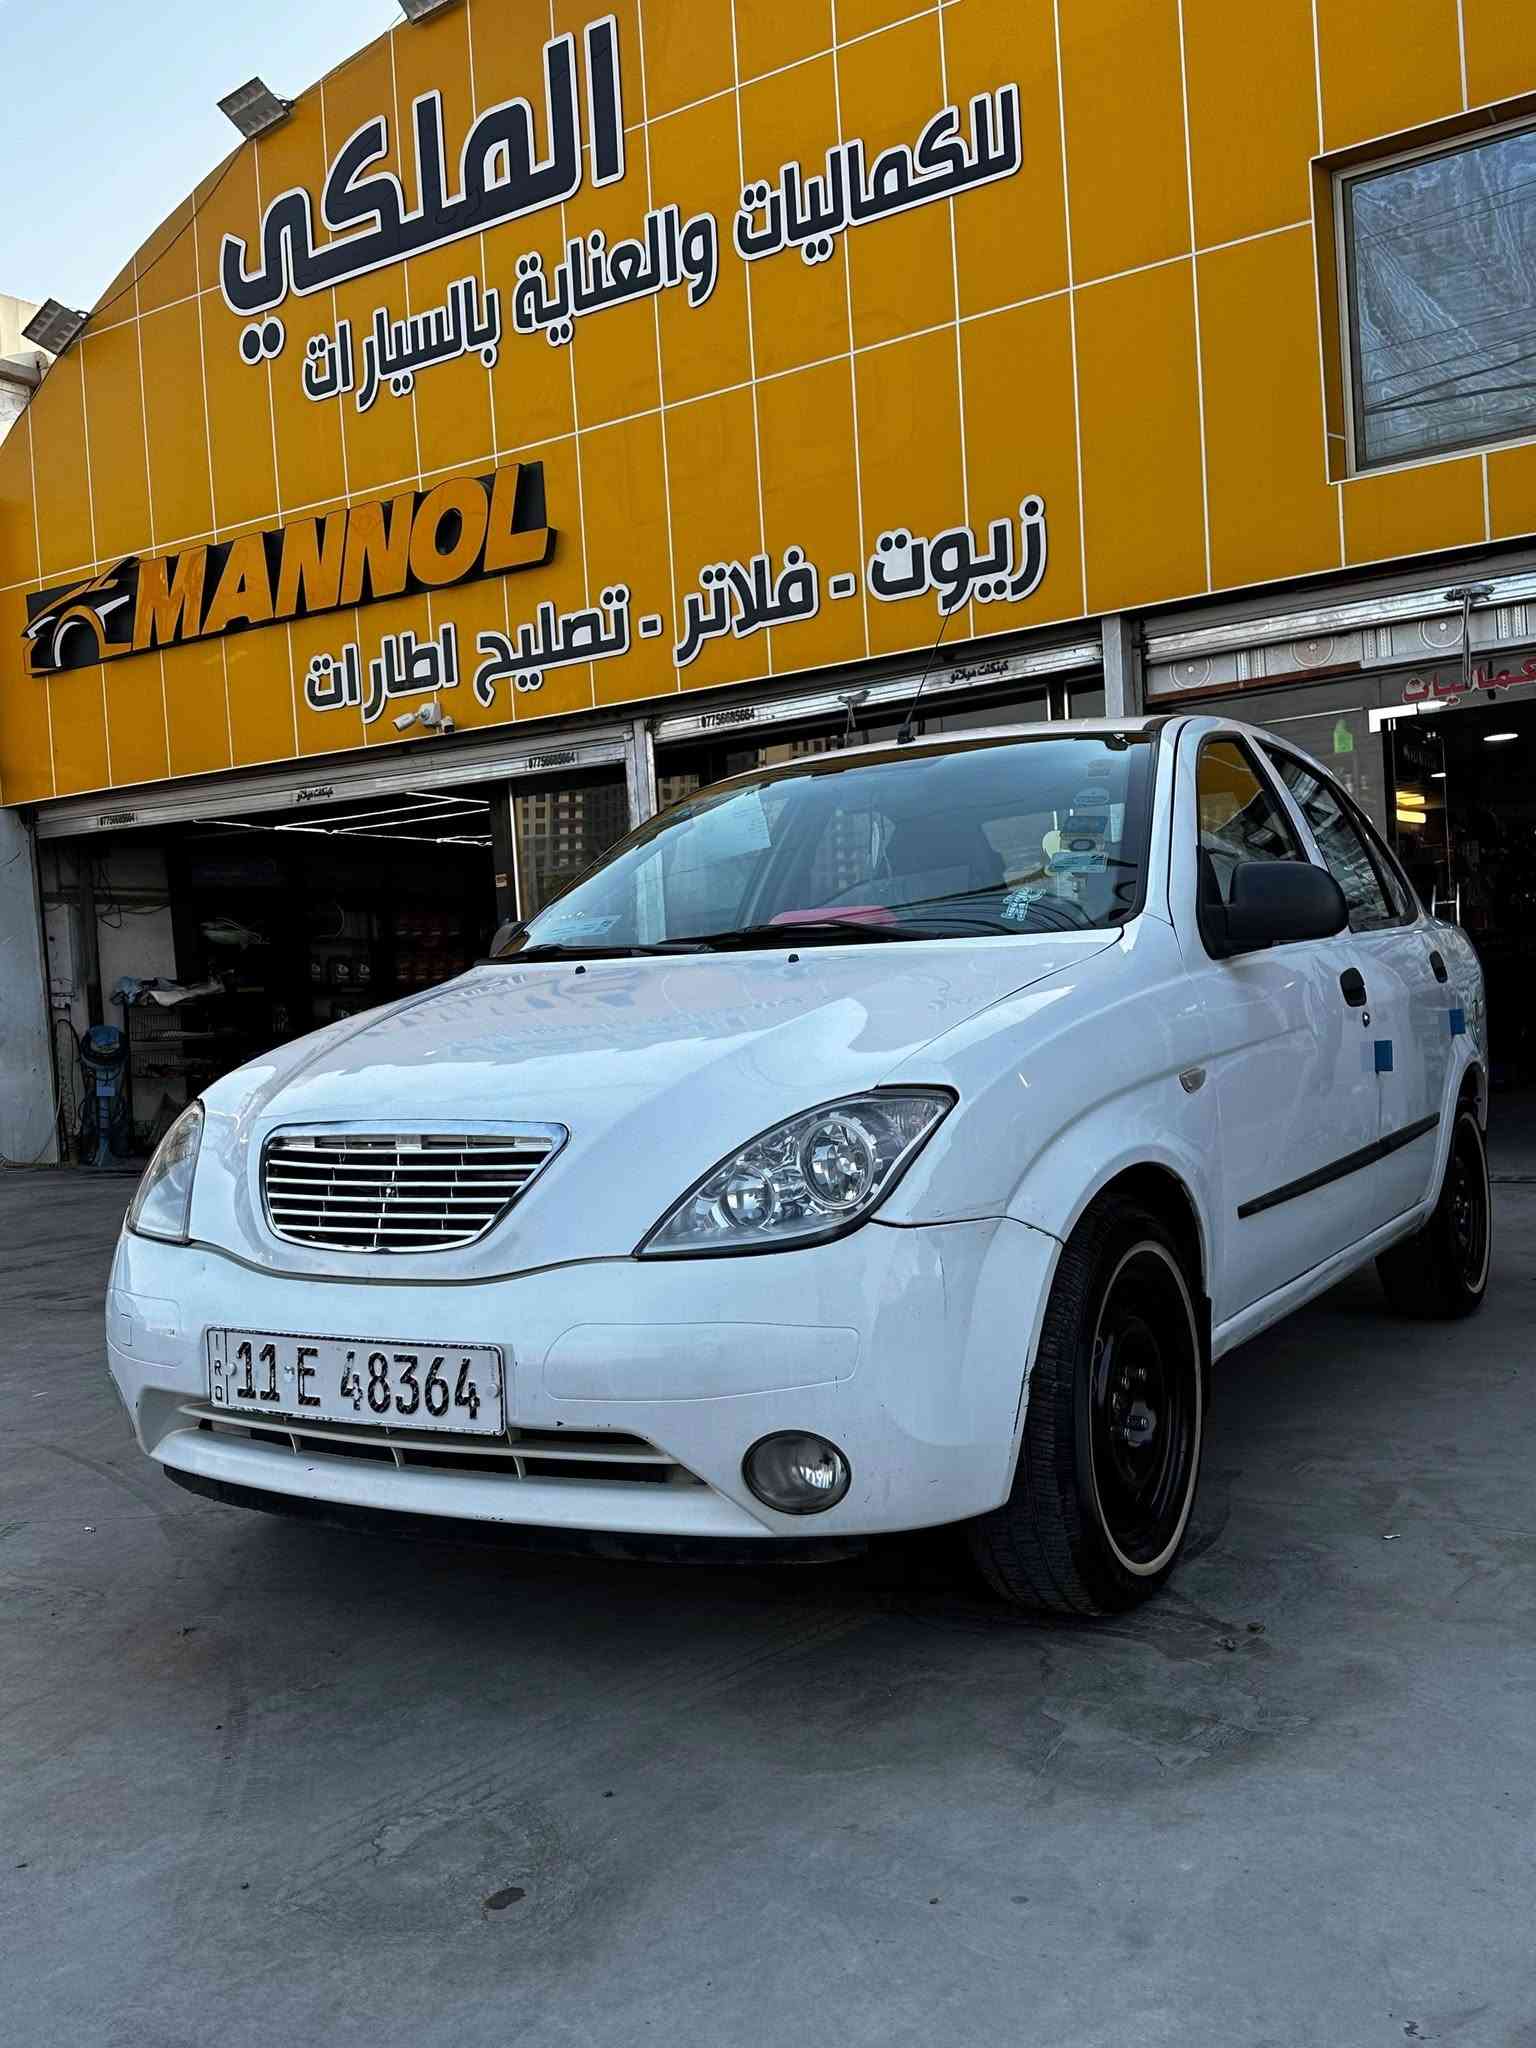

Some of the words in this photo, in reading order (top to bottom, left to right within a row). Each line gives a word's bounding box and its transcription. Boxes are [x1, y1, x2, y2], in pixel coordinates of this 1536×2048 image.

[219, 14, 624, 365] الملكي
[733, 83, 1023, 265] للكماليات
[512, 203, 717, 347] والعناية
[301, 275, 501, 413] بالسيارات
[132, 461, 557, 651] MANNOL
[673, 545, 818, 667] فلاتر
[866, 494, 1047, 616] زيوت
[304, 621, 459, 724] اطارات
[473, 584, 630, 707] تصليح
[237, 1341, 280, 1402] 11
[297, 1346, 321, 1406] E
[340, 1351, 480, 1419] 48364
